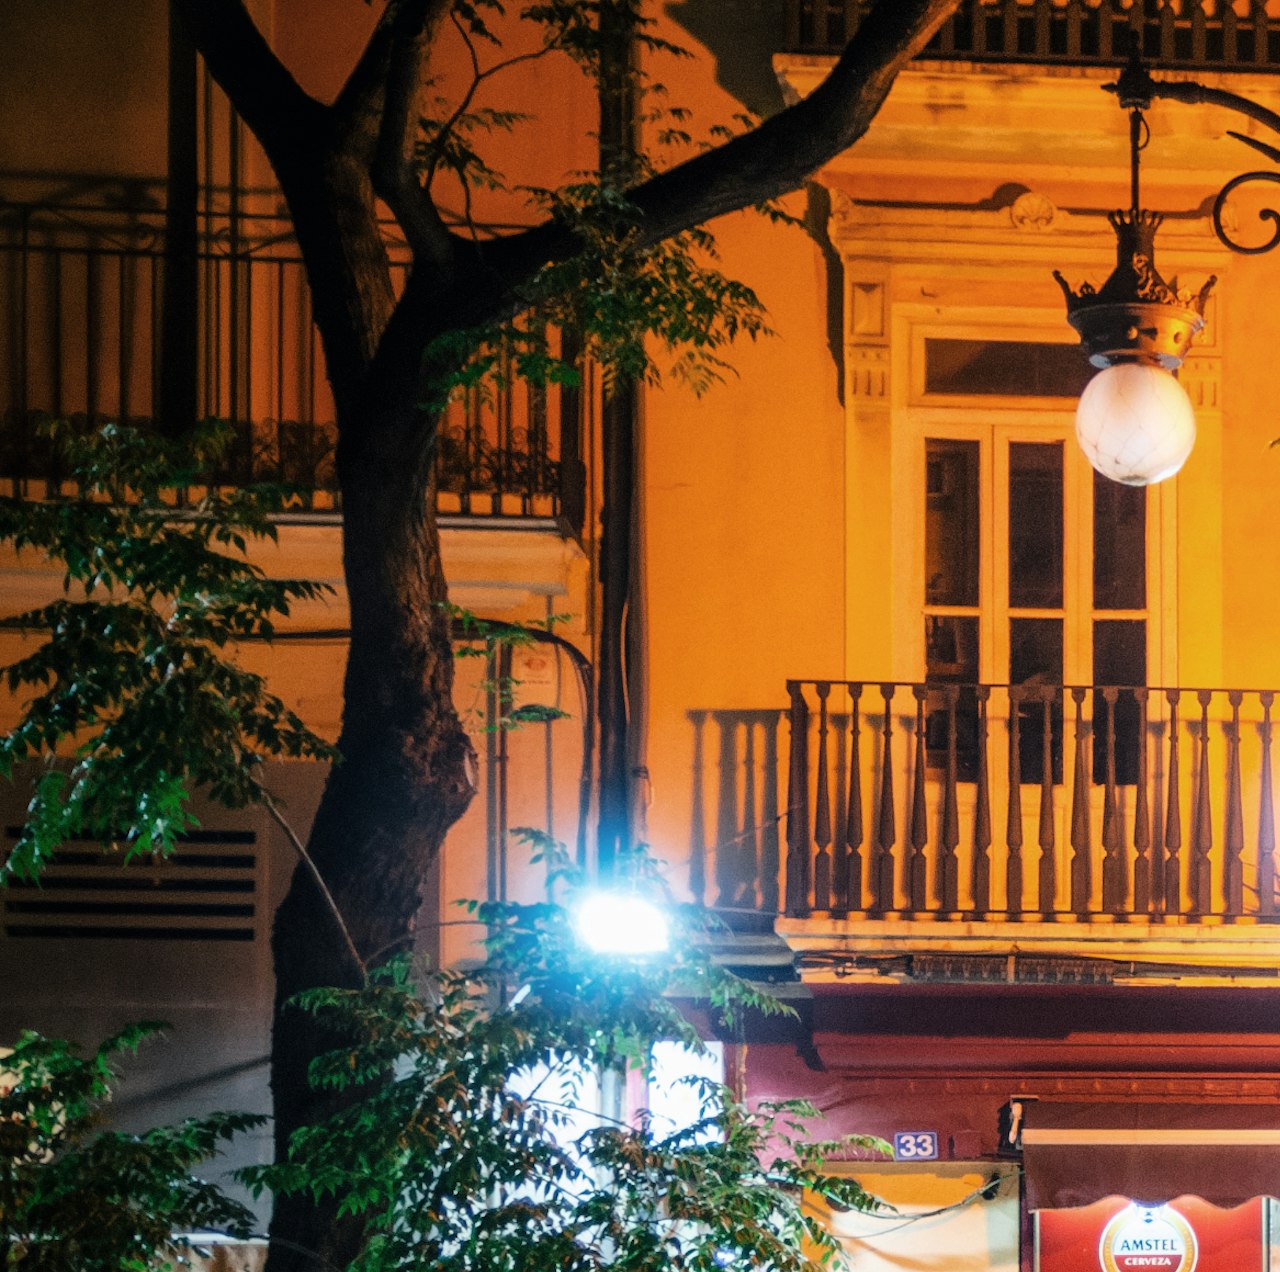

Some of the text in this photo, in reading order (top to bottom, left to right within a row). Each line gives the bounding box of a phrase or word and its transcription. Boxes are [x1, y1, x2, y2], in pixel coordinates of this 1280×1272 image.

[900, 1135, 933, 1157] 33
[1121, 1239, 1178, 1251] AMSTEL
[1124, 1257, 1171, 1266] CERVEZA
